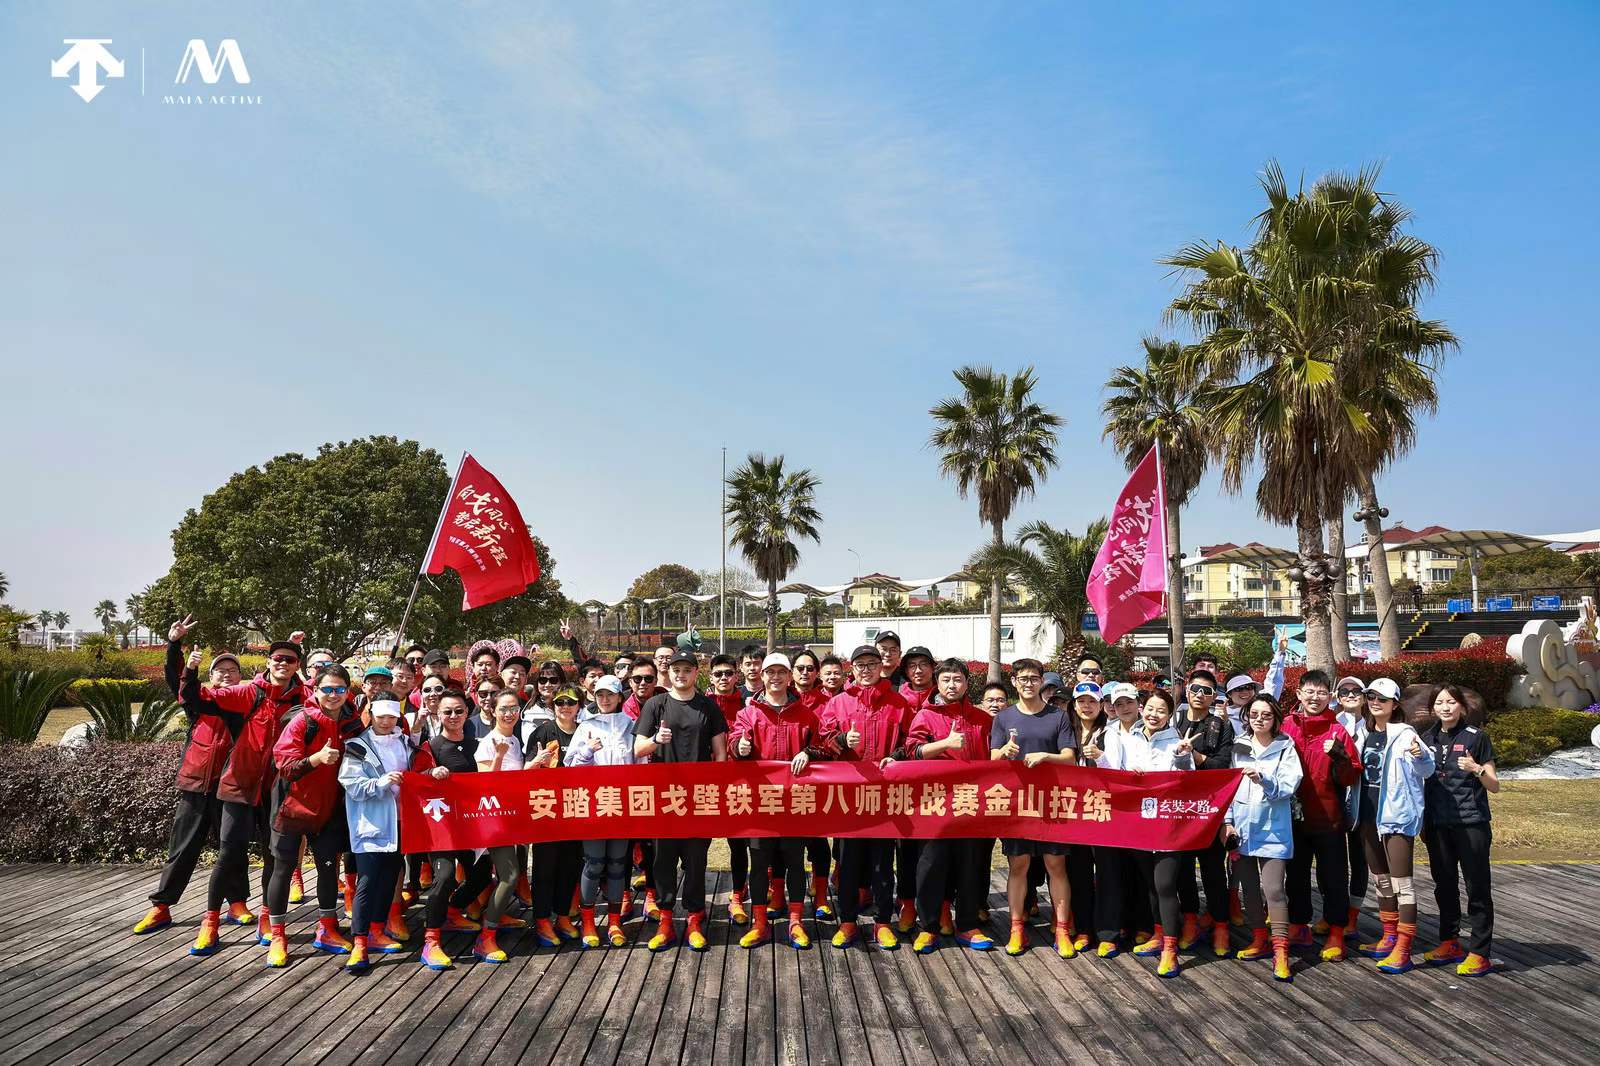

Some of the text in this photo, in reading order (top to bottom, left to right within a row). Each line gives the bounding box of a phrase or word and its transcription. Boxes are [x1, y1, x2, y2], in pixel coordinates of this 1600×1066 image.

[529, 783, 1112, 822] 安踏集团戈壁铁军第八师挑战赛金山拉练
[1159, 799, 1210, 815] 玄奘之路
